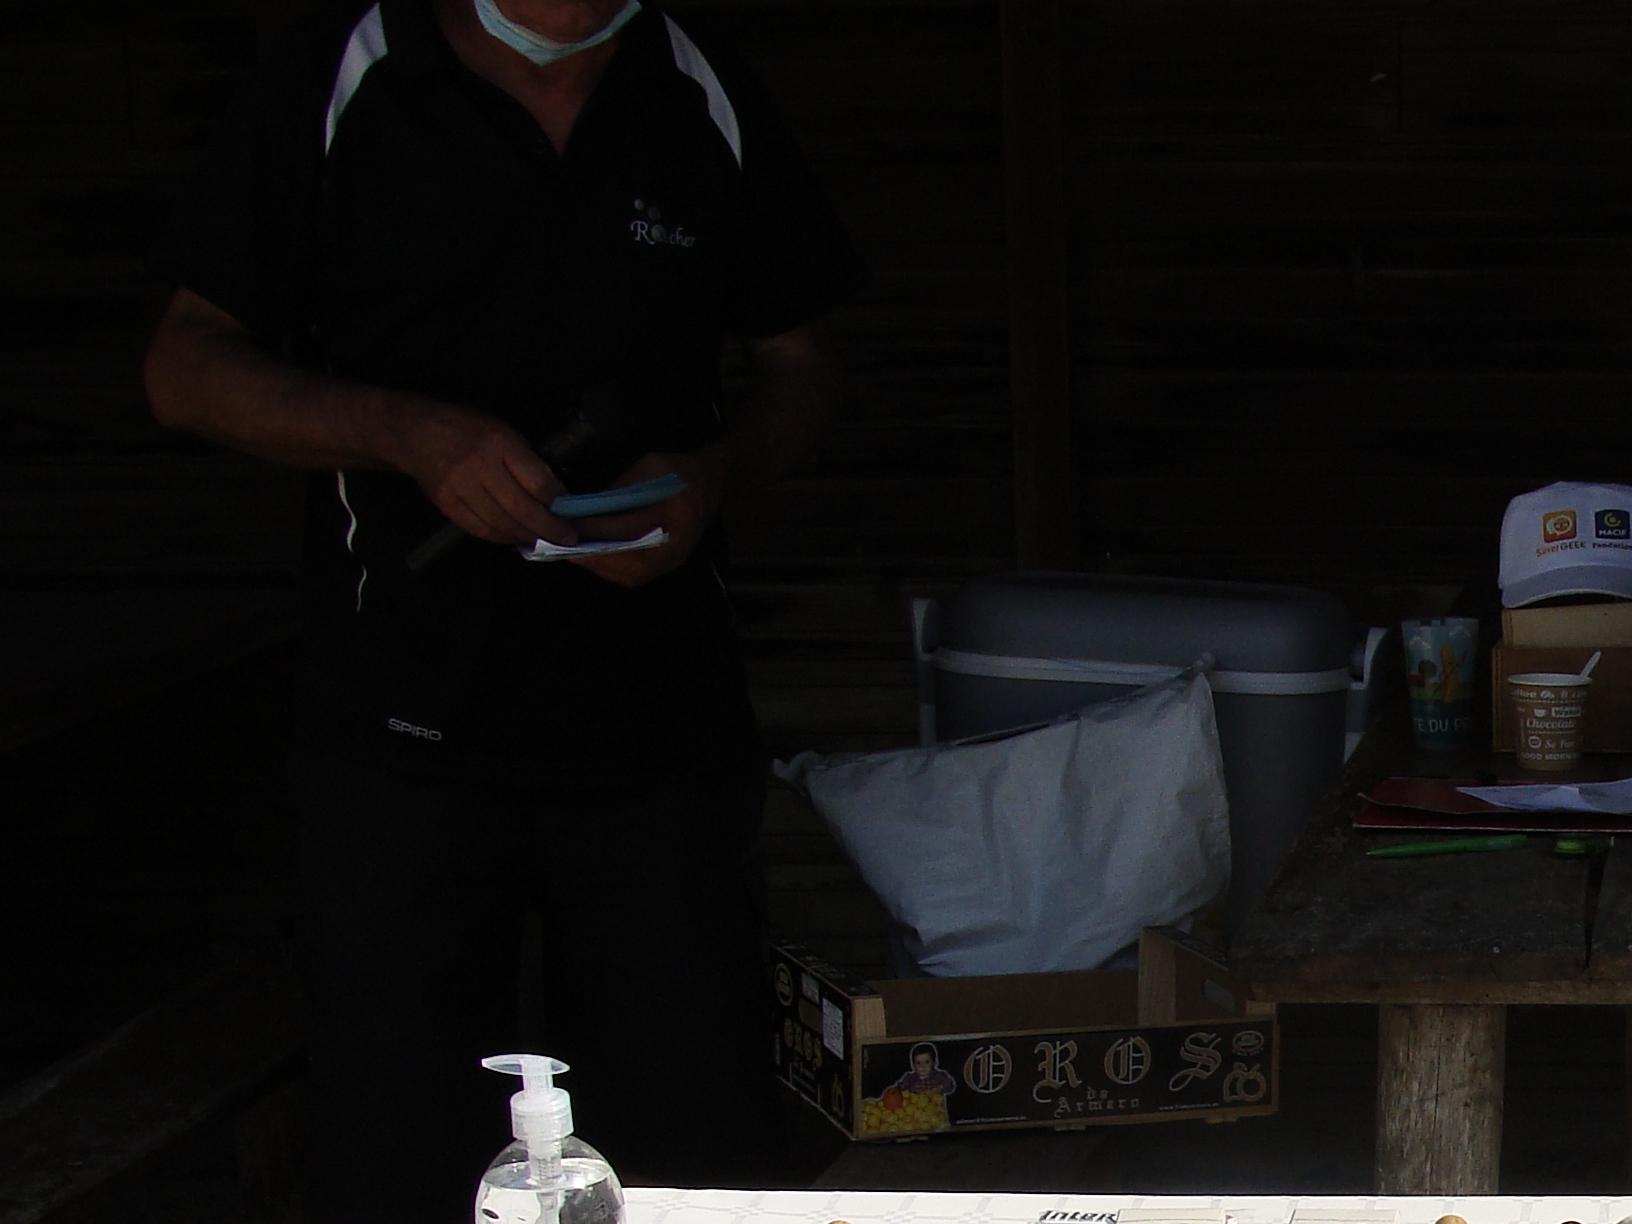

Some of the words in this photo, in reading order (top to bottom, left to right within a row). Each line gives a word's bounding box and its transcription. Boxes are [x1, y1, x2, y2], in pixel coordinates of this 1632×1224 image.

[387, 717, 442, 741] SPIRO
[1429, 719, 1449, 733] DU
[1040, 1210, 1117, 1222] Inter
